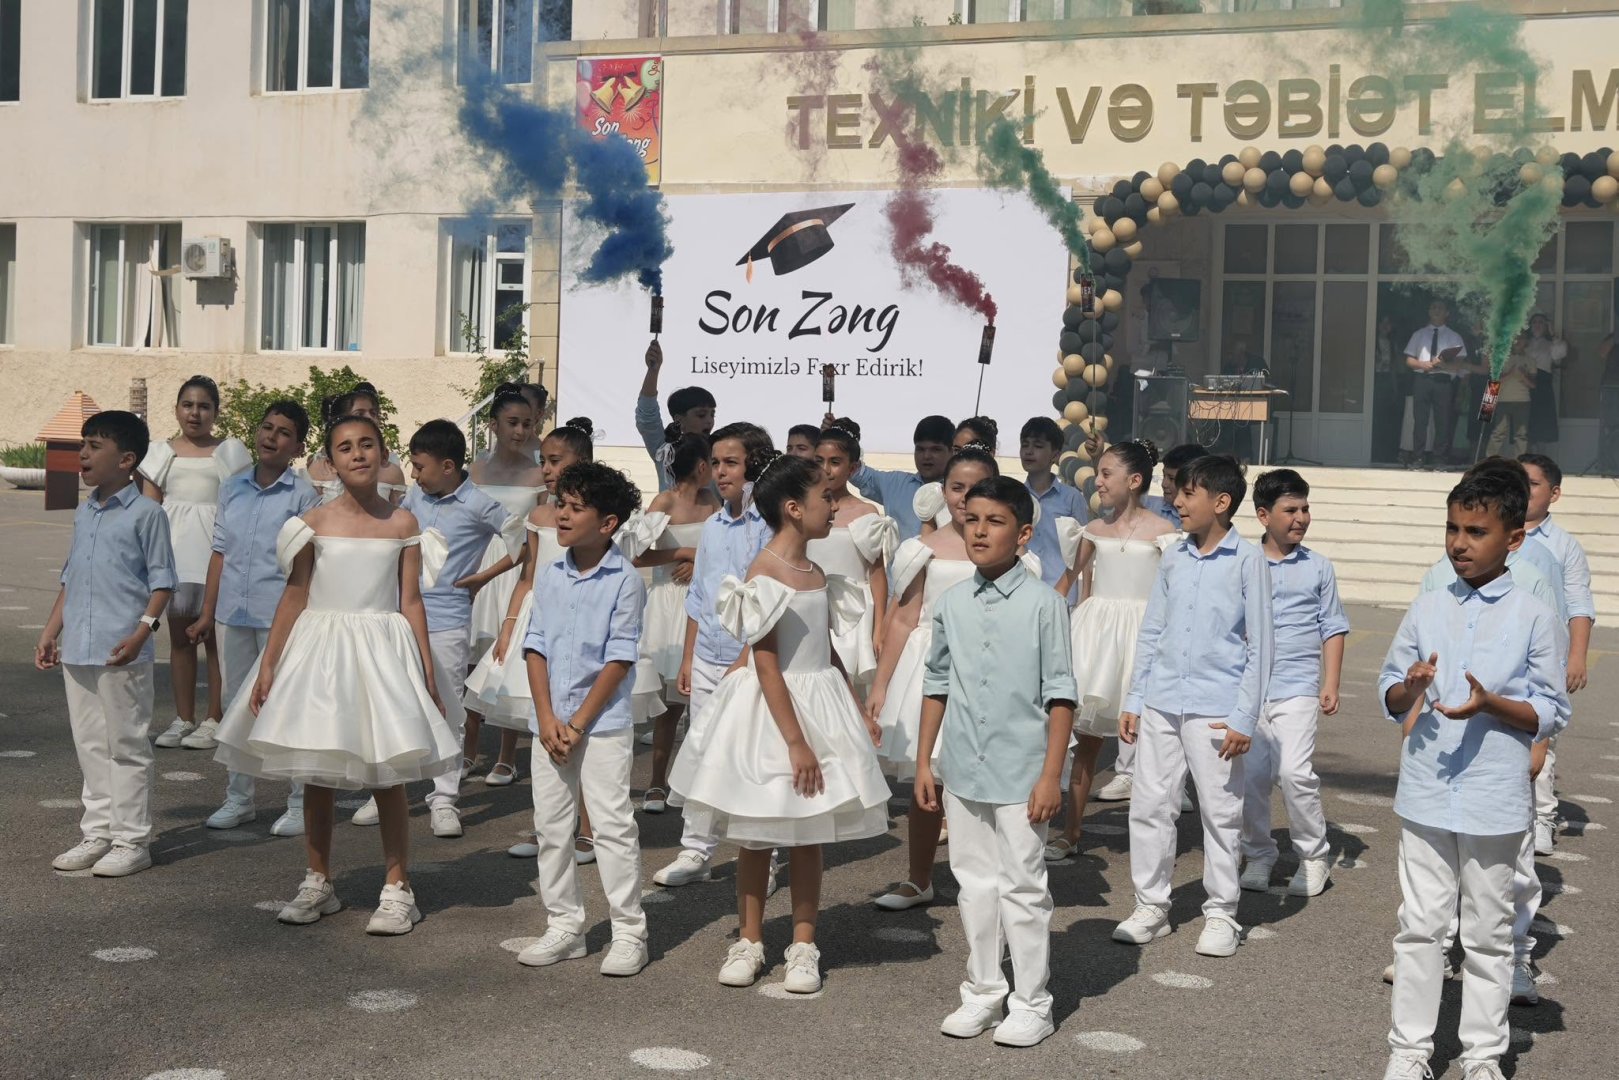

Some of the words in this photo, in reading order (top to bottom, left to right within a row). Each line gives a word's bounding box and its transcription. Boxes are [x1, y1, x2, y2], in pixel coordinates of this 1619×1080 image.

[592, 117, 619, 135] Son
[786, 75, 1036, 150] TEXNİKİ
[1055, 83, 1153, 145] VƏ
[1176, 63, 1448, 142] TƏBİƏT
[699, 290, 780, 335] Son
[788, 290, 900, 353] Zəng
[691, 356, 800, 378] Liseyimizlə
[856, 357, 924, 377] Edirik!
